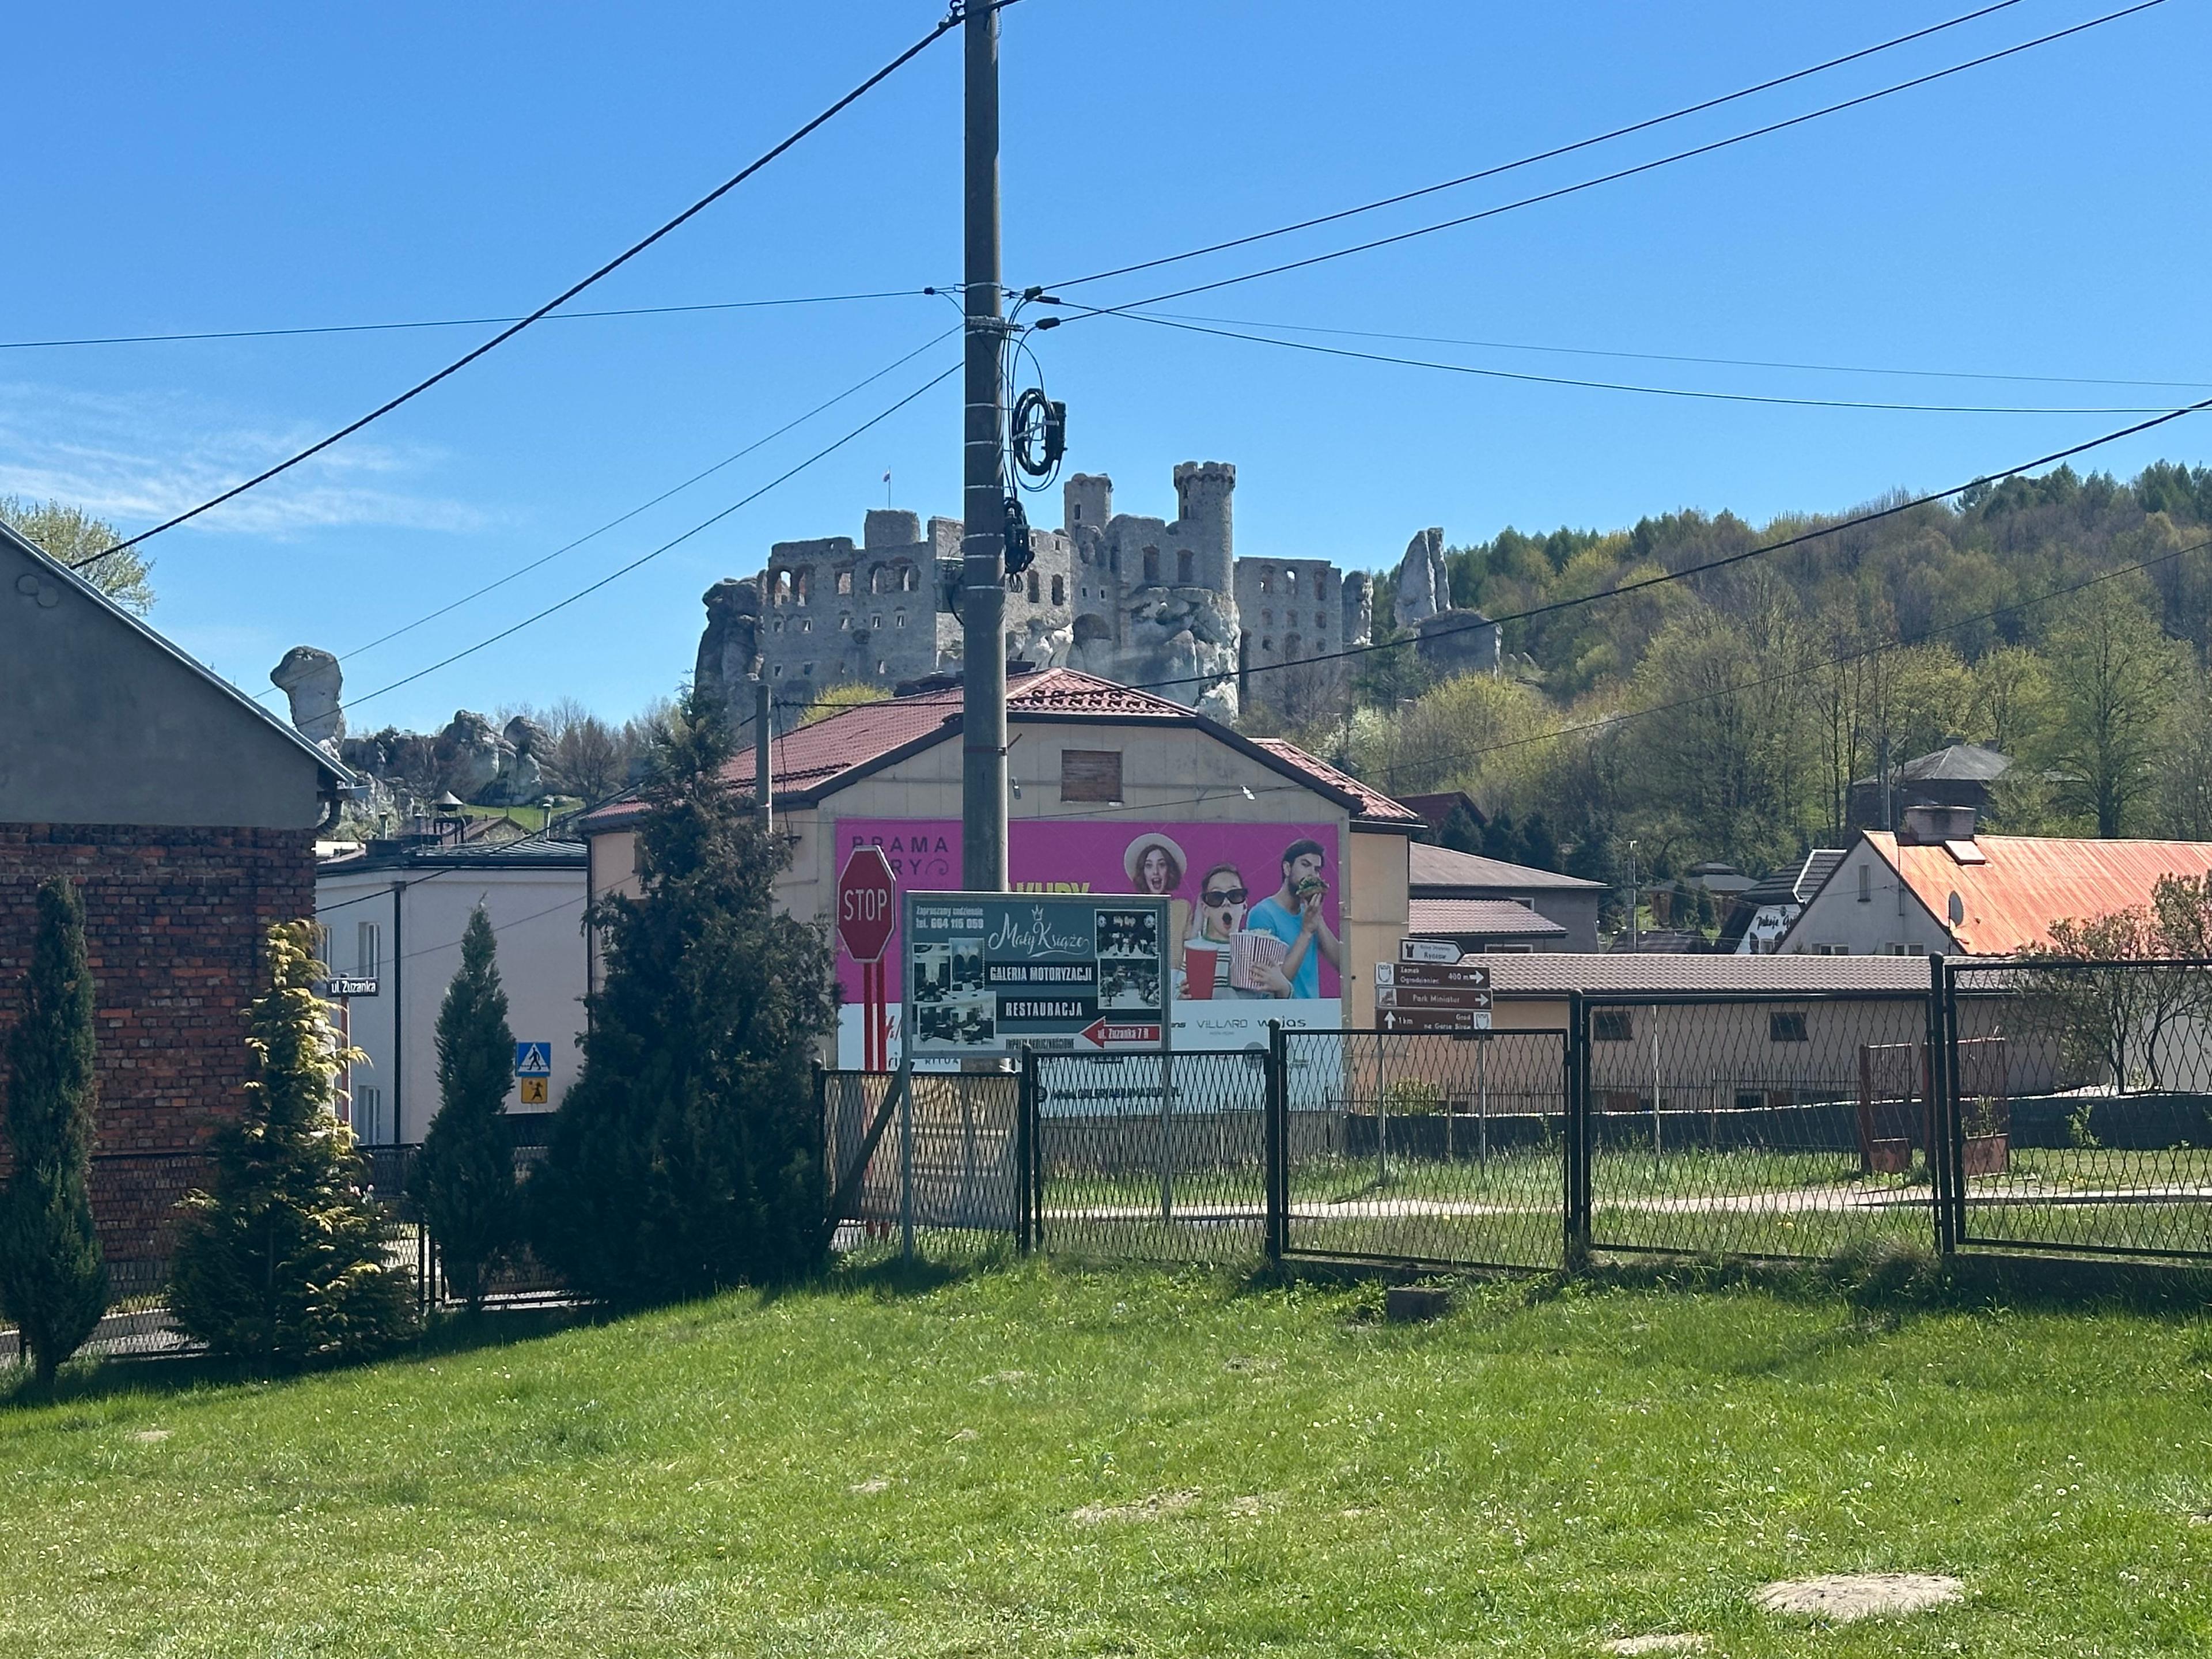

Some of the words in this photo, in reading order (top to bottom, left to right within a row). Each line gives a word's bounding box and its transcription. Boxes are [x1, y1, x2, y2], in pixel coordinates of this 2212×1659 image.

[844, 889, 888, 921] STOP
[990, 967, 1028, 982] GALERIA
[1029, 967, 1093, 982] MOTORYZACJI
[1448, 972, 1462, 980] 400
[342, 980, 376, 993] Zuzanka
[1412, 994, 1428, 1002] Park
[1430, 995, 1460, 1003] Miniatur
[1005, 1002, 1083, 1017] RESTAURACJA
[1196, 1018, 1248, 1029] VILLARD
[1257, 1015, 1307, 1028] wjas
[1108, 1028, 1137, 1039] Zuzanka
